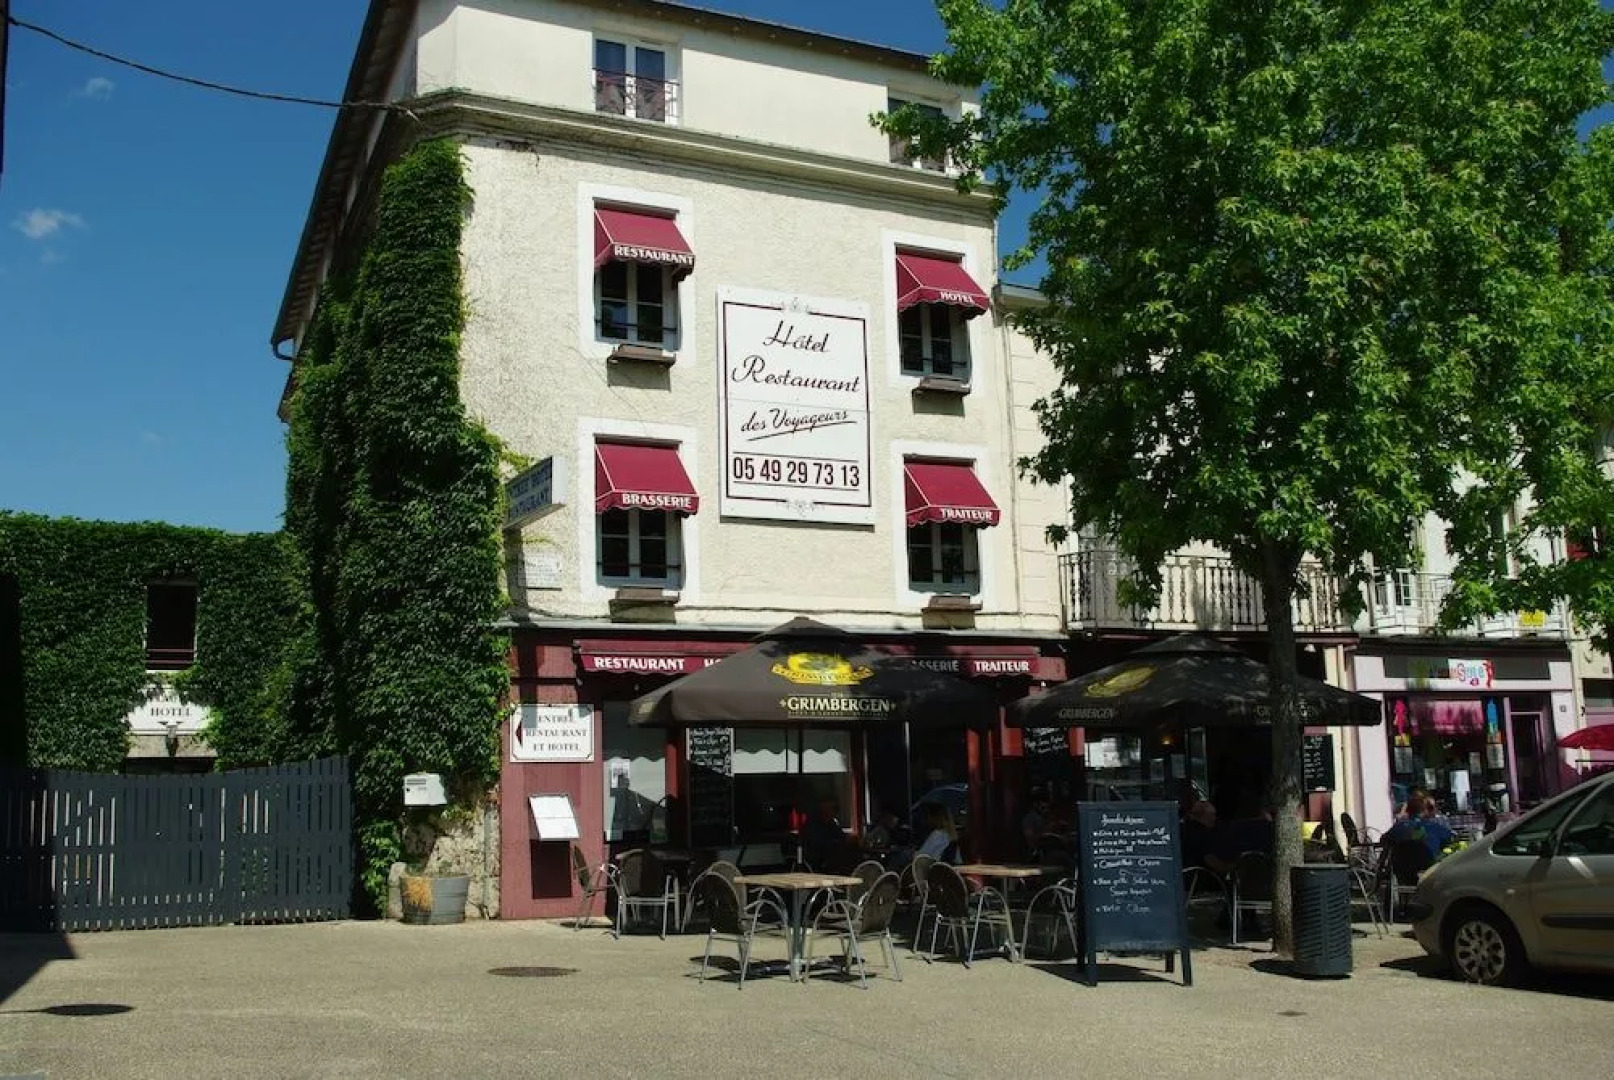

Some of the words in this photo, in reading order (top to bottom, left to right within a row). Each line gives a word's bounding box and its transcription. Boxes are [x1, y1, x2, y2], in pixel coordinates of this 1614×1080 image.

[614, 245, 693, 265] RESTAURANT
[762, 320, 829, 353] Hôtel
[731, 354, 860, 393] Restaurant
[740, 411, 766, 432] des
[769, 407, 849, 434] Voyageurs
[733, 456, 755, 480] 05
[760, 459, 782, 482] 49
[787, 461, 808, 484] 29
[813, 462, 834, 485] 73
[840, 465, 860, 487] 13
[622, 493, 692, 508] BRASSERIE
[941, 508, 993, 520] TRAITEUR
[594, 656, 685, 671] RESTAURANT
[974, 660, 1030, 672] TRAITEUR
[787, 696, 890, 712] GRIMBERGEN
[526, 729, 587, 737] RESTAURANT
[534, 743, 544, 751] ET
